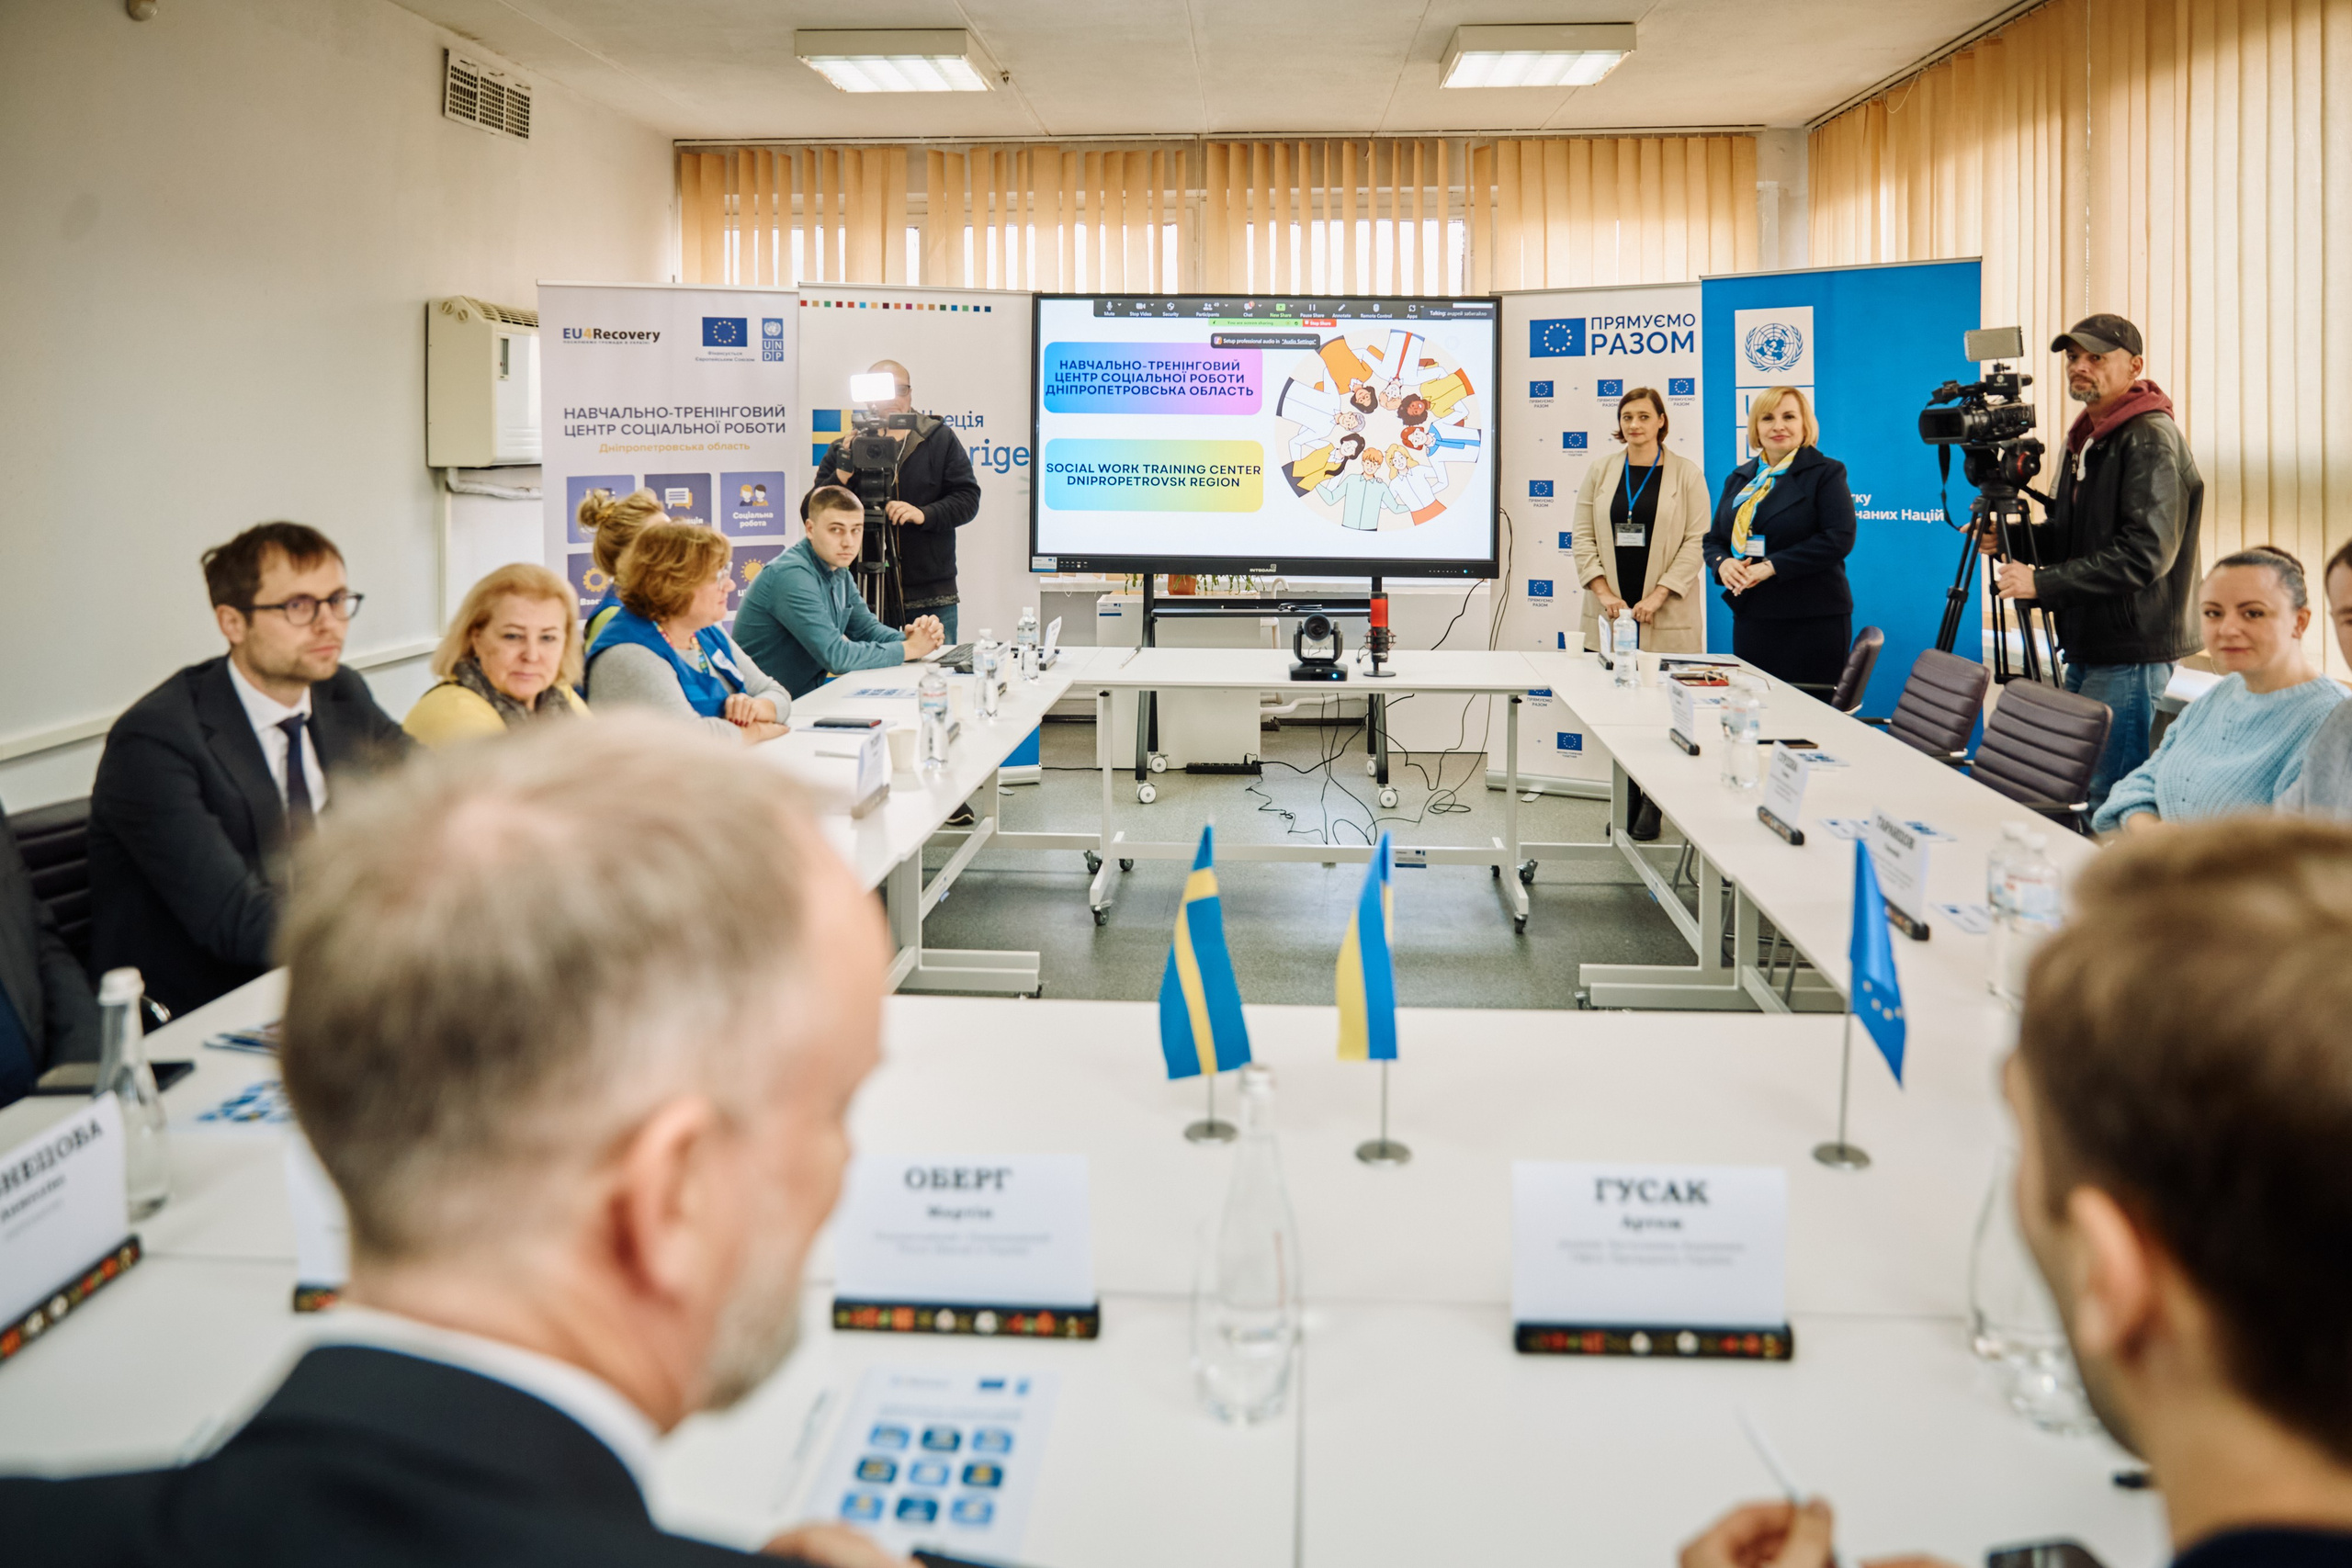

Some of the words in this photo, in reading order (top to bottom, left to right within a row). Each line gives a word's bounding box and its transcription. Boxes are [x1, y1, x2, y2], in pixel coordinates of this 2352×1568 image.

[1590, 313, 1696, 330] ПРЯМУЄМО
[562, 327, 661, 343] EU4Recovery
[1590, 331, 1694, 355] РАЗОМ
[1059, 359, 1240, 371] НАВЧАЛЬНО-ТРЕНІНГОВИЙ
[1055, 372, 1098, 383] ЦЕНТР
[1101, 371, 1186, 384] СОЦІАЛЬНОЇ
[1190, 374, 1245, 384] РОБОТИ
[1046, 385, 1186, 396] ДНІПРОПЕТРОВСЬКА
[1190, 386, 1254, 396] ОБЛАСТЬ
[563, 404, 786, 420] НАВЧАЛЬНО-ТРЕНІНГОВИЙ
[564, 423, 616, 437] ЦЕНТР
[621, 420, 720, 436] СОЦІАЛЬНОЇ
[724, 423, 786, 434] РОБОТИ
[599, 444, 705, 454] Дніпропетровська
[707, 442, 751, 451] область
[969, 438, 1030, 474] rige
[1046, 463, 1094, 473] SOCIAL
[1098, 464, 1139, 474] WORK
[1143, 464, 1206, 474] TRAINING
[1209, 465, 1261, 475] CENTER
[1067, 476, 1186, 487] DNIPROPETROVSK
[1190, 477, 1240, 487] REGION
[732, 511, 774, 520] Соціальна
[1901, 508, 1945, 524] Націй
[740, 520, 766, 528] робота
[903, 1166, 1012, 1190] ОБЕРГ
[1594, 1177, 1709, 1204] ГУСАК
